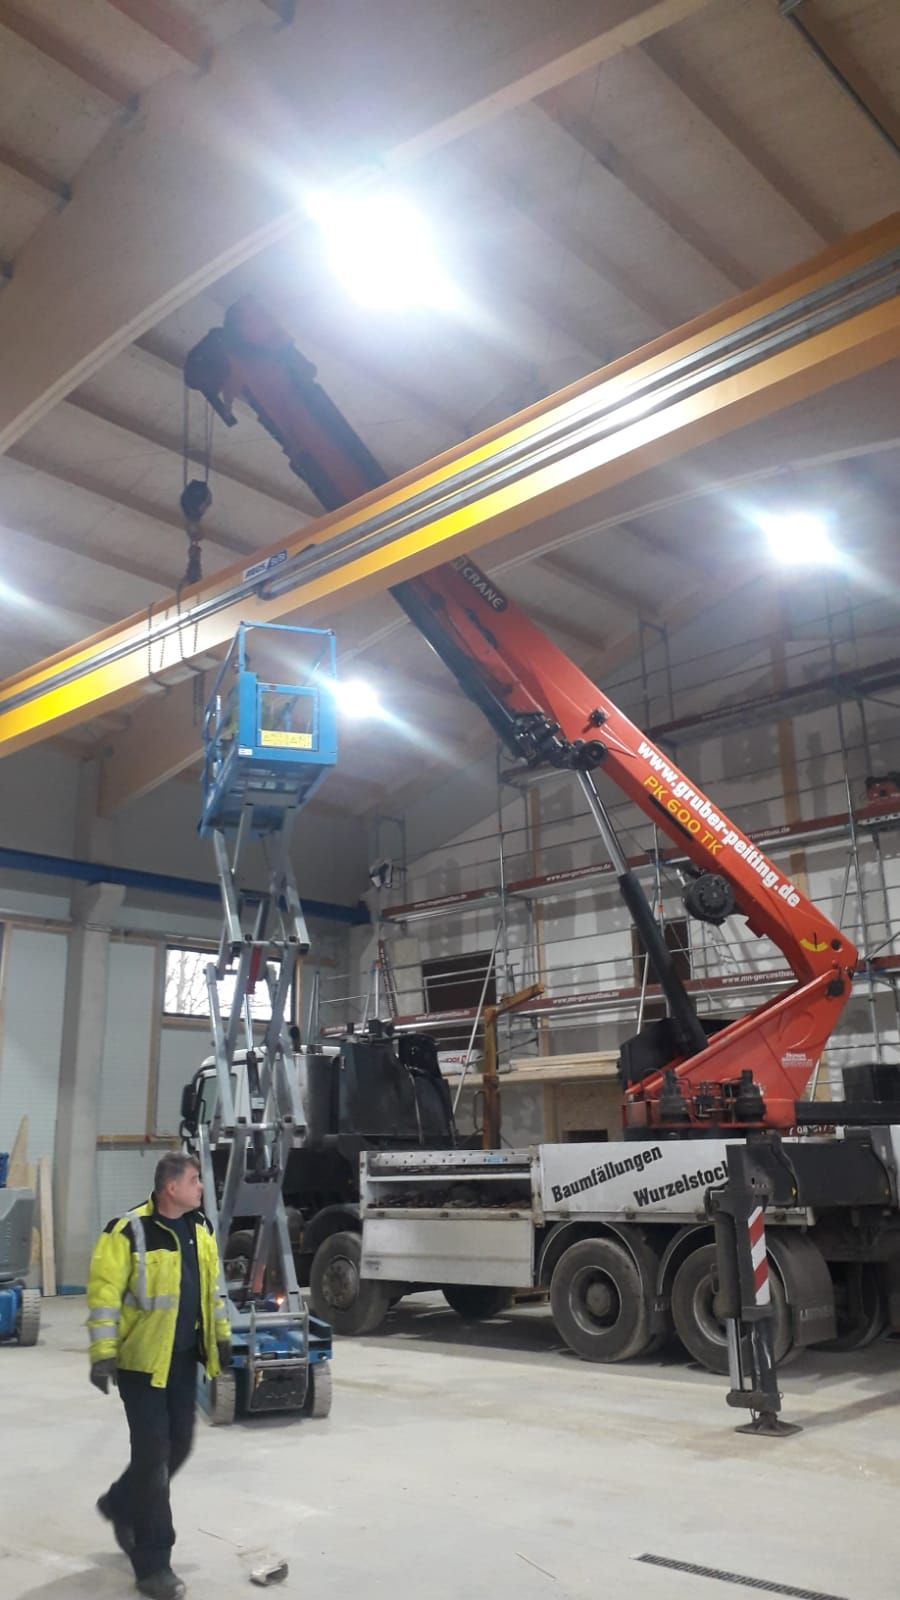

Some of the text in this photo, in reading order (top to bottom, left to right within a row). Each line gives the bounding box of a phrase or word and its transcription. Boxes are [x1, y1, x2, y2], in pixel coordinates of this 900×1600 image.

[463, 567, 504, 609] CRANE
[637, 742, 801, 907] www.gruber-peiting.de
[644, 776, 723, 856] PK 600 TK
[552, 1146, 664, 1203] Baumfällungen
